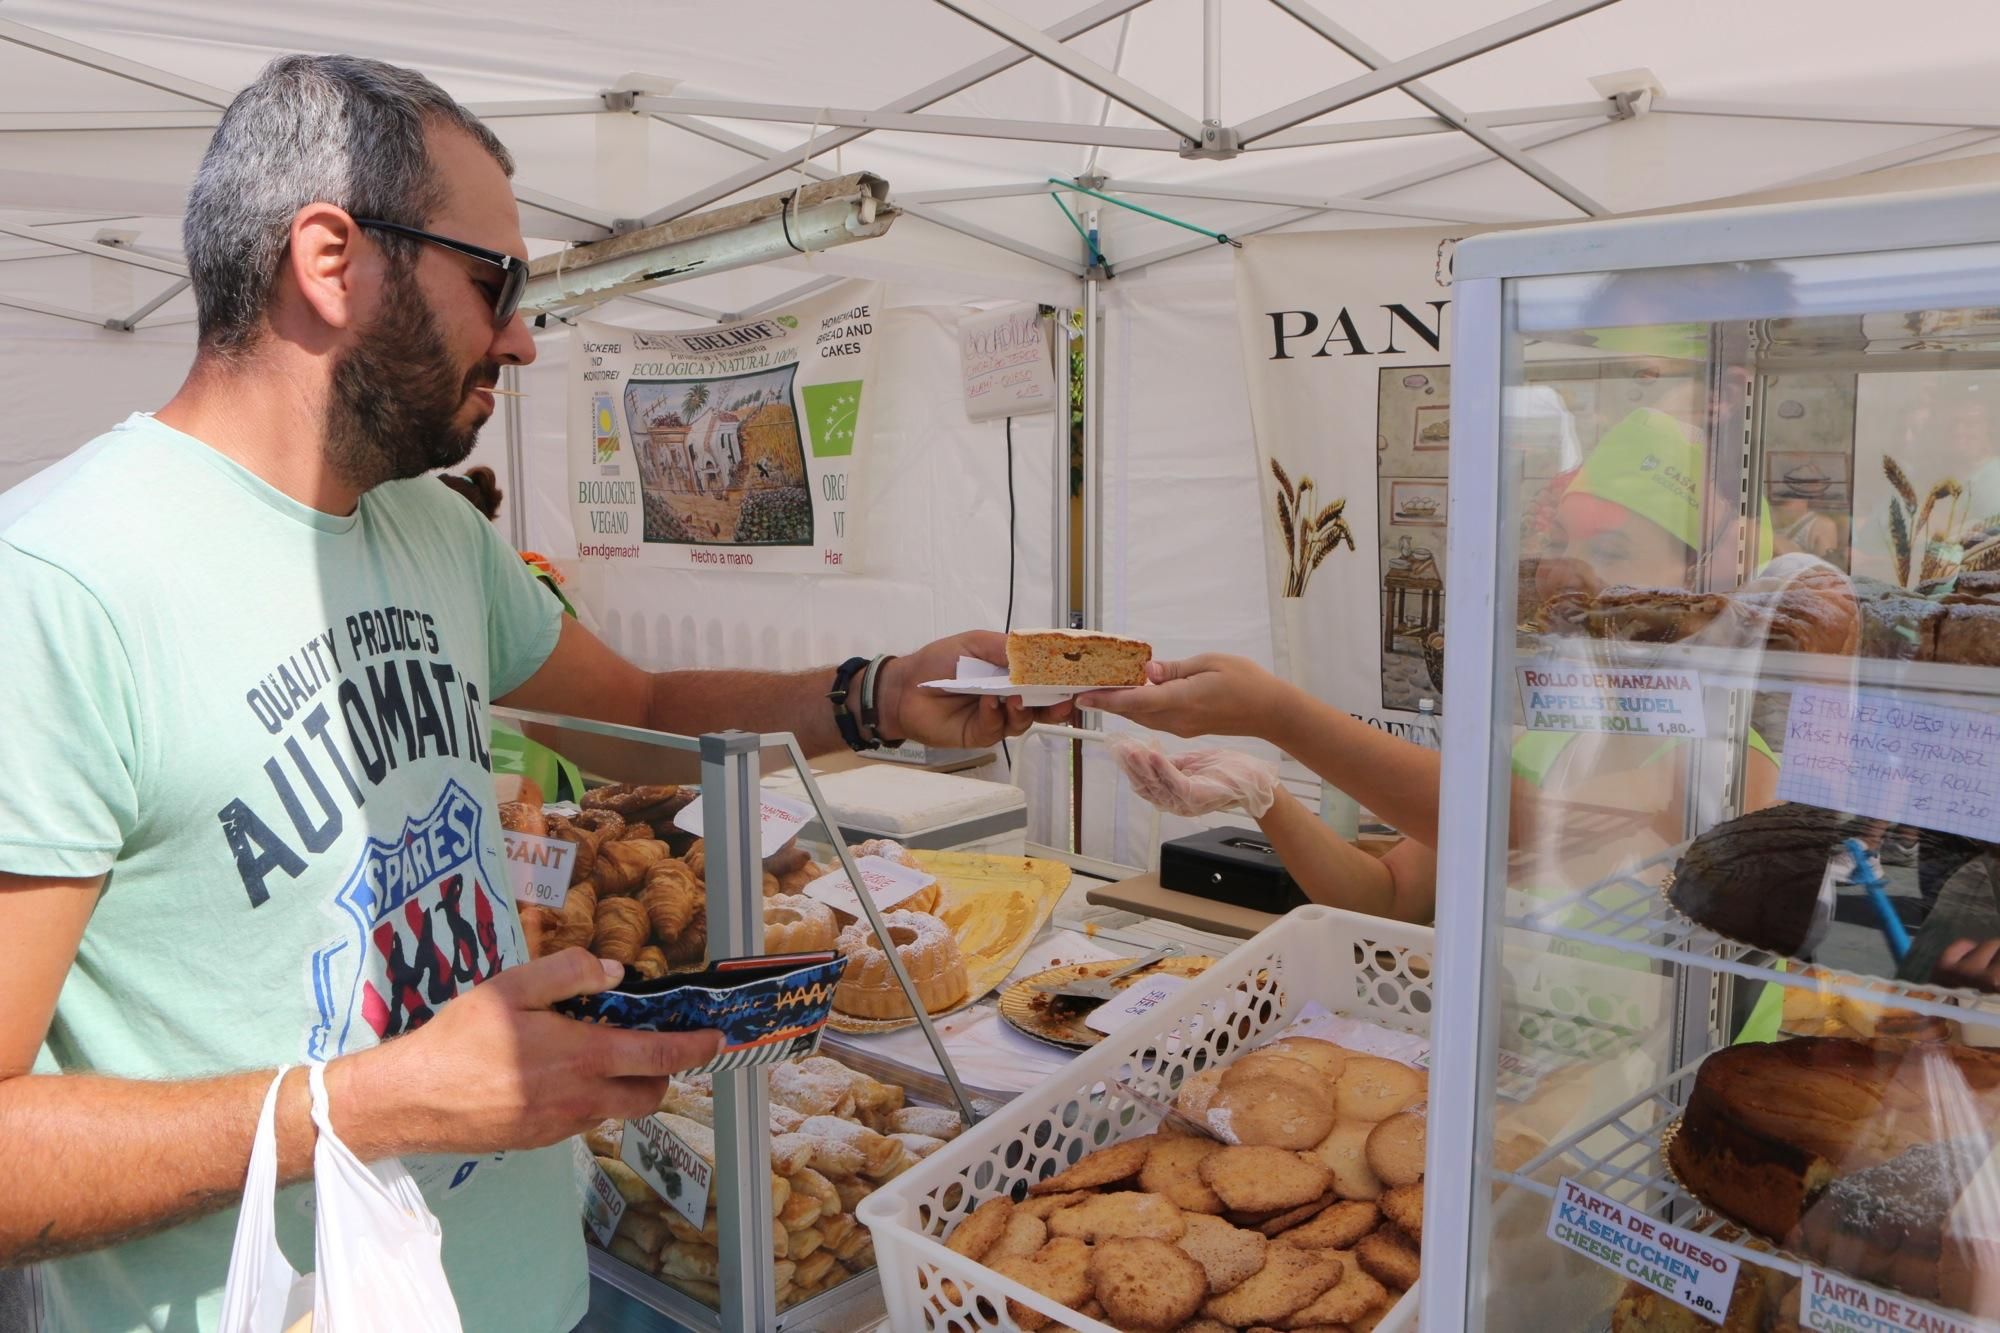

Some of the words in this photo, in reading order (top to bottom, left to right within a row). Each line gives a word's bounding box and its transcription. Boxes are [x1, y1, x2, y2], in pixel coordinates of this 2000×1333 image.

[682, 323, 773, 351] EDELHOF
[846, 323, 873, 338] AND
[821, 342, 861, 358] CAKES
[632, 363, 705, 376] ECOLOGICA
[718, 355, 770, 373] NATURAL
[578, 481, 636, 505] BIOLOGISCH
[823, 474, 848, 501] ORG
[590, 511, 628, 534] VEGANO
[691, 548, 717, 564] Hecho
[719, 553, 726, 564] a
[727, 553, 754, 565] mano
[246, 628, 342, 735] QUALITY
[1524, 670, 1578, 688] ROLLO
[1582, 674, 1604, 688] DE
[1606, 674, 1693, 690] MANZANA
[1530, 691, 1682, 714] APFELSTRUDEL
[1534, 711, 1594, 730] APPLE
[1600, 716, 1649, 732] ROLL
[1966, 722, 2000, 744] MA
[217, 660, 490, 908] AUTOMATIC
[1940, 773, 1991, 797] ROLL
[365, 797, 472, 922] SPARES
[663, 1130, 708, 1190] CHOCOLATE
[1566, 1182, 1623, 1226] TARTA
[1627, 1216, 1656, 1240] DE
[1658, 1231, 1728, 1274] QUESO
[1559, 1202, 1700, 1285] KÄSEKUCHEN
[1554, 1223, 1624, 1268] CHEESE
[1625, 1258, 1677, 1294] CAKE
[1811, 1270, 1870, 1312] TARTA
[1874, 1297, 1901, 1323] DE
